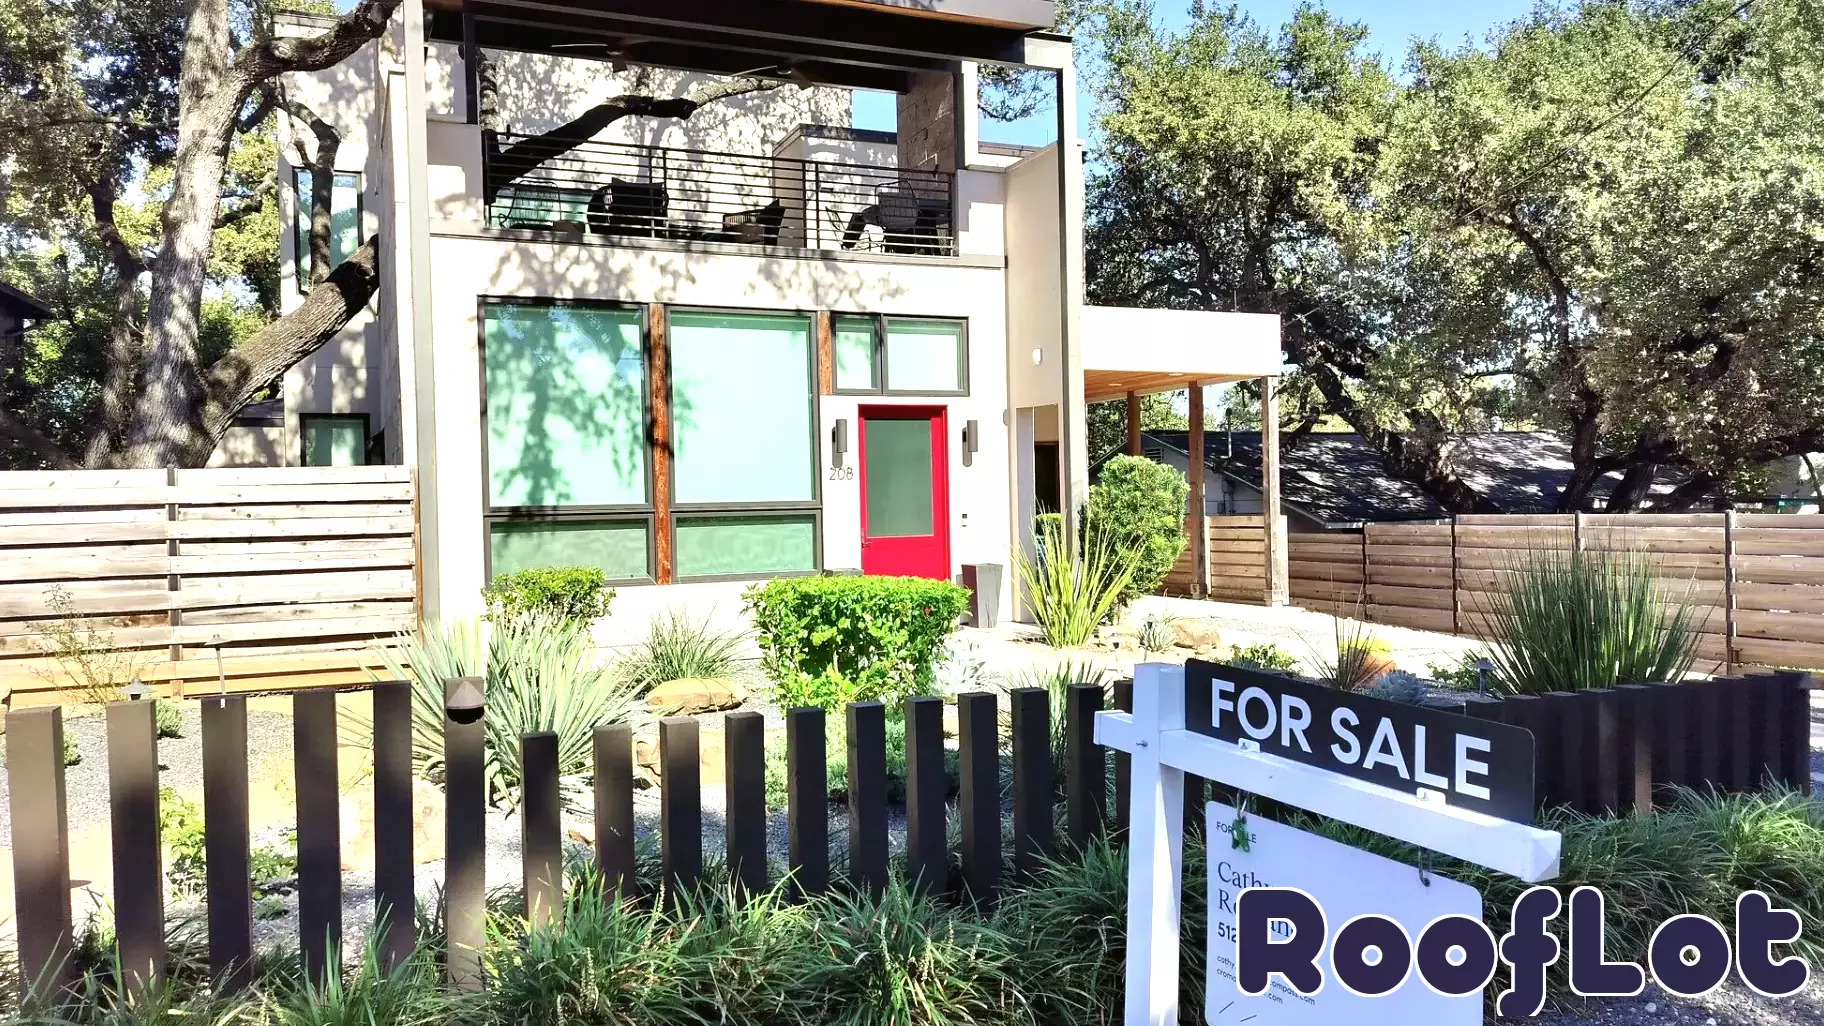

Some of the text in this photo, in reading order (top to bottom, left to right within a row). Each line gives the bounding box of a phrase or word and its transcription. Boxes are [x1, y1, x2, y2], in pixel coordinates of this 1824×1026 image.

[829, 467, 854, 481] 208
[1211, 677, 1491, 801] FOR SALE
[1217, 861, 1276, 889] Cath
